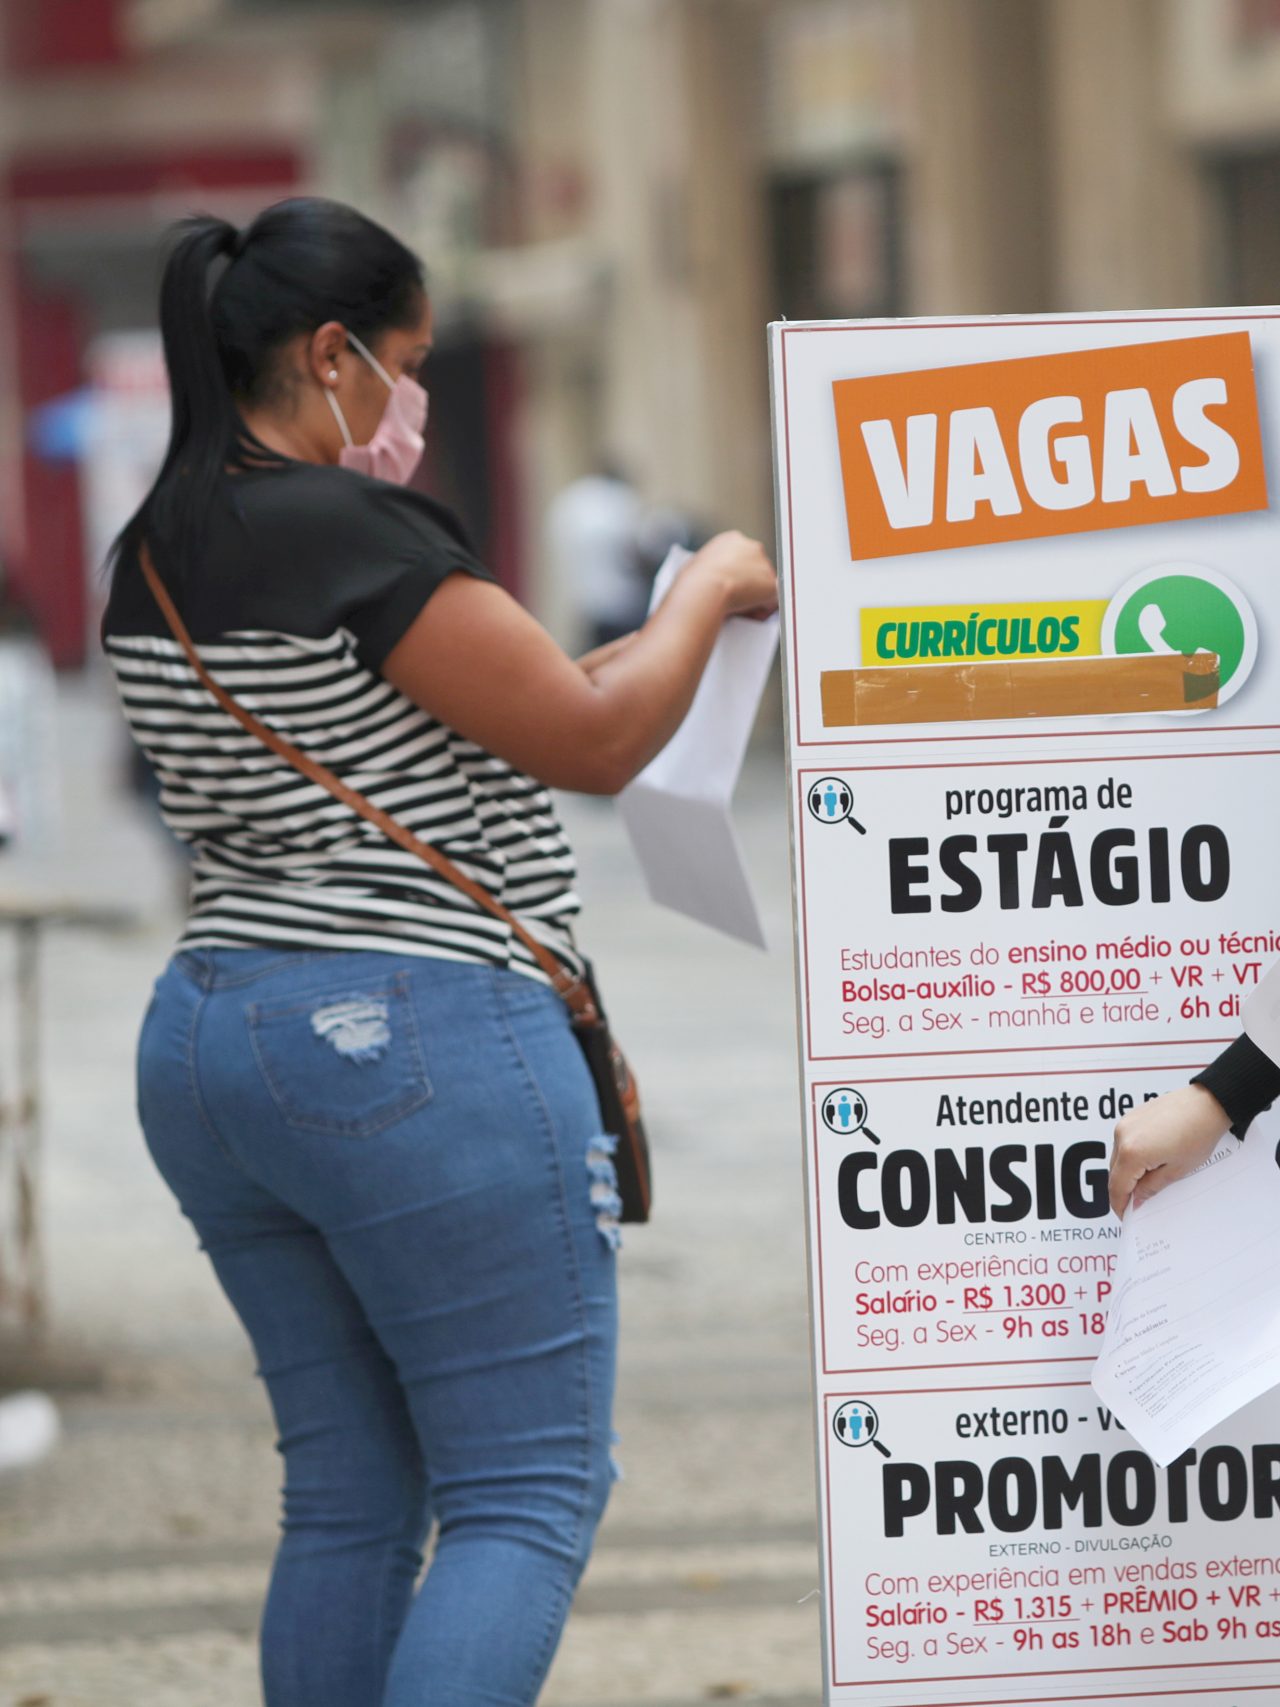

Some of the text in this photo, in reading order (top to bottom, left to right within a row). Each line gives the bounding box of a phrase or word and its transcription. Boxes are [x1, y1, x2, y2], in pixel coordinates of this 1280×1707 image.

[860, 377, 1240, 529] VAGAS
[876, 612, 1079, 658] CURRÍCULOS
[945, 777, 1133, 820] programa de
[888, 815, 1230, 914] ESTÁGIO
[840, 945, 961, 971] Estudantes
[970, 942, 999, 965] do
[1008, 939, 1087, 964] ensino
[1096, 934, 1172, 960] médio
[1180, 938, 1210, 957] ou
[841, 974, 995, 1002] Bolsa-auxílio
[1022, 969, 1050, 997] R$
[1059, 968, 1141, 994] 800,00
[1170, 964, 1203, 988] VR
[1232, 962, 1262, 985] VT
[842, 1011, 890, 1039] Seg.
[898, 1013, 913, 1032] a
[921, 1007, 963, 1031] Sex
[988, 1002, 1071, 1028] manhã
[1080, 1005, 1095, 1024] e
[1102, 997, 1160, 1023] tarde
[1180, 995, 1210, 1019] 6h
[936, 1087, 1134, 1126] Atendente de
[963, 1230, 1027, 1246] CENTRO
[1040, 1227, 1094, 1243] METRO
[855, 1254, 1116, 1285] Com experiência comp
[855, 1290, 937, 1316] Salário
[963, 1286, 993, 1311] R$
[1003, 1283, 1066, 1307] 1.300
[857, 1325, 905, 1351] Seg.
[913, 1326, 928, 1344] a
[936, 1320, 978, 1342] Sex
[1002, 1317, 1033, 1339] 9h
[1041, 1319, 1069, 1337] as
[1079, 1311, 1109, 1335] 18
[955, 1407, 1069, 1438] externo
[988, 1541, 1061, 1557] EXTERNO
[1074, 1533, 1173, 1553] DIVULGAÇÃO
[865, 1573, 919, 1596] Com
[927, 1566, 1059, 1597] experiência
[1068, 1567, 1106, 1585] em
[1114, 1556, 1198, 1583] vendas
[865, 1602, 947, 1627] Salário
[974, 1597, 1004, 1623] R$
[1014, 1595, 1072, 1620] 1.315
[1103, 1585, 1198, 1614] PRÊMIO
[1228, 1585, 1261, 1607] VR
[866, 1636, 916, 1663] Seg.
[923, 1638, 938, 1656] a
[946, 1632, 989, 1655] Sex
[1013, 1628, 1043, 1651] 9h
[1052, 1631, 1080, 1648] as
[1090, 1624, 1131, 1647] 18h
[1140, 1627, 1154, 1644] e
[1161, 1618, 1208, 1643] Sab
[1217, 1616, 1247, 1640] 9h
